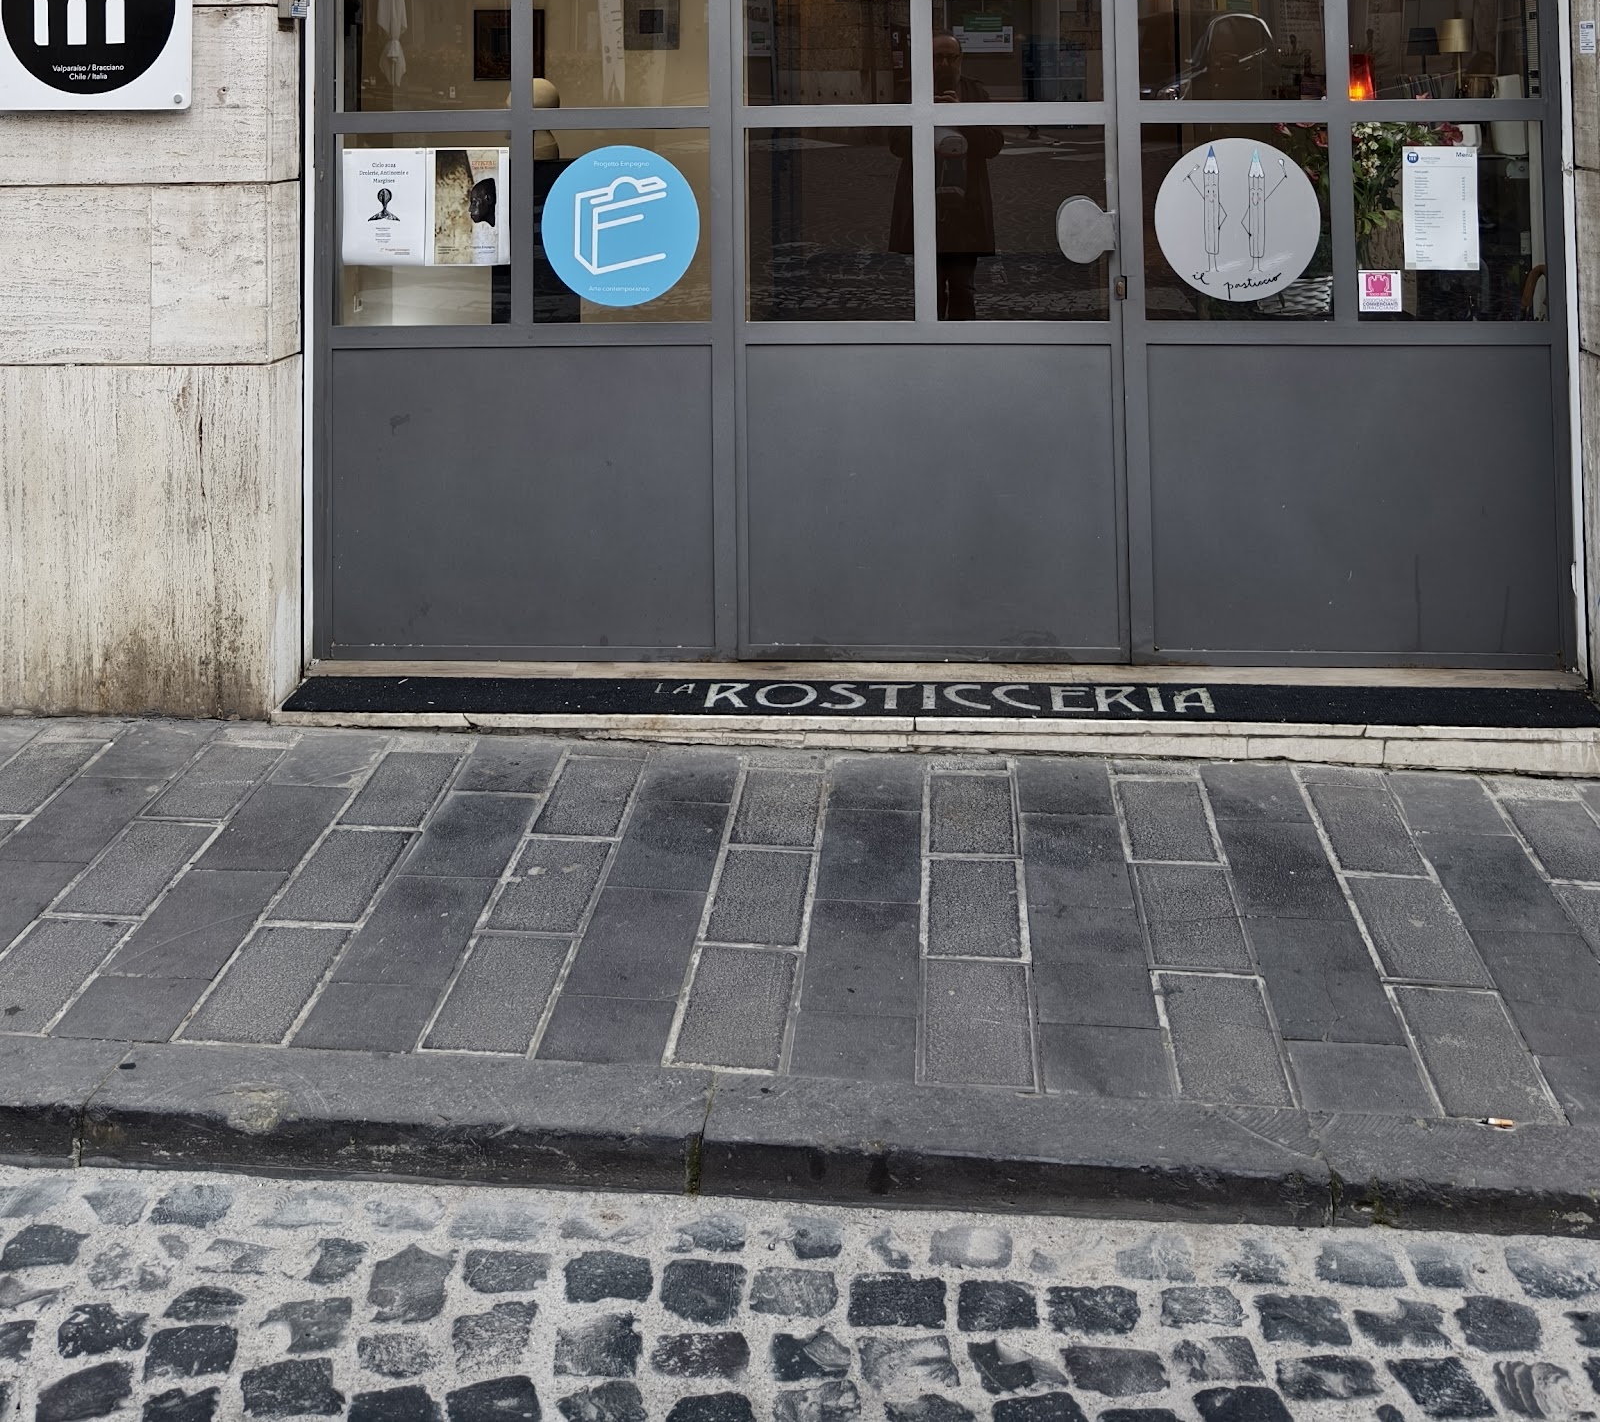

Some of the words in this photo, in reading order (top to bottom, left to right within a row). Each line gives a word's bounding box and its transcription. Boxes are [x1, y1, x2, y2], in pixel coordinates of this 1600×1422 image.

[69, 72, 86, 80] Chile
[92, 72, 107, 80] Italia
[593, 160, 619, 168] Progetto
[1192, 271, 1210, 285] il
[1223, 272, 1282, 299] pasticcio
[654, 682, 696, 694] LA
[703, 682, 1216, 713] ROSTICCERIA
